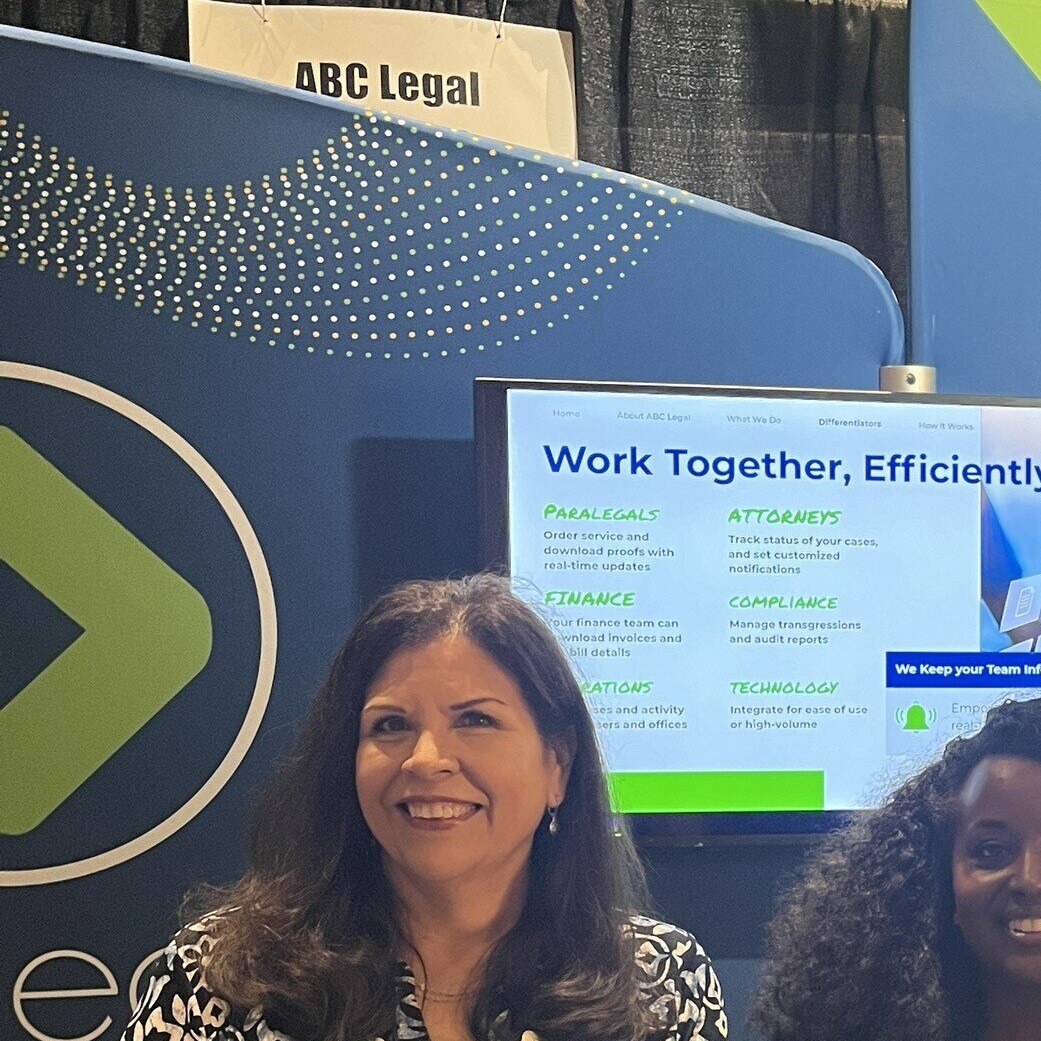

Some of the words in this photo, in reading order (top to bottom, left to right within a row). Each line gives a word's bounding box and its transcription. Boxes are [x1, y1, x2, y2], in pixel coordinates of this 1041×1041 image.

[295, 62, 368, 100] ABC
[379, 64, 480, 108] Legal
[552, 409, 581, 419] Home
[617, 411, 645, 421] About
[646, 412, 665, 421] ABC
[667, 413, 691, 423] Legal
[726, 415, 750, 424] What
[752, 416, 767, 424] We
[769, 417, 781, 425] Do
[818, 417, 882, 428] Differentiators
[918, 421, 938, 430] How
[947, 422, 974, 431] Works
[543, 445, 653, 475] Work
[664, 448, 851, 487] Together,
[543, 503, 660, 521] PARALEGALS
[728, 508, 843, 525] ATTORNEYS
[543, 530, 578, 541] Order
[581, 531, 623, 541] service
[627, 532, 649, 542] and
[728, 534, 760, 544] Track
[763, 535, 798, 545] status
[801, 536, 813, 545] of
[815, 537, 842, 547] your
[844, 538, 879, 548] cases,
[543, 546, 604, 556] download
[607, 546, 645, 558] proofs
[648, 547, 675, 557] with
[728, 550, 750, 559] and
[753, 550, 771, 559] set
[774, 550, 840, 561] customized
[544, 560, 599, 570] real-time
[602, 561, 650, 572] updates
[728, 564, 801, 574] notifications
[544, 591, 636, 606] FINANCE
[728, 595, 838, 609] COMPLIANCE
[576, 618, 621, 628] finance
[624, 619, 655, 628] team
[658, 620, 679, 628] can
[729, 620, 775, 631] Manage
[778, 619, 862, 631] transgressions
[608, 633, 656, 643] invoices
[660, 634, 682, 643] and
[729, 635, 751, 644] and
[754, 634, 785, 644] audit
[787, 636, 829, 646] reports
[591, 648, 631, 657] details
[895, 663, 917, 675] We
[919, 663, 952, 677] Keep
[954, 665, 983, 677] your
[986, 663, 1021, 675] Team
[730, 681, 839, 695] TECHNOLOGY
[616, 705, 638, 714] and
[641, 704, 685, 716] activity
[730, 705, 783, 716] Integrate
[786, 705, 801, 714] for
[805, 707, 831, 715] ease
[834, 705, 846, 714] of
[849, 707, 868, 715] use
[623, 720, 646, 730] and
[648, 719, 688, 730] offices
[730, 720, 742, 729] or
[745, 719, 818, 731] high-volume
